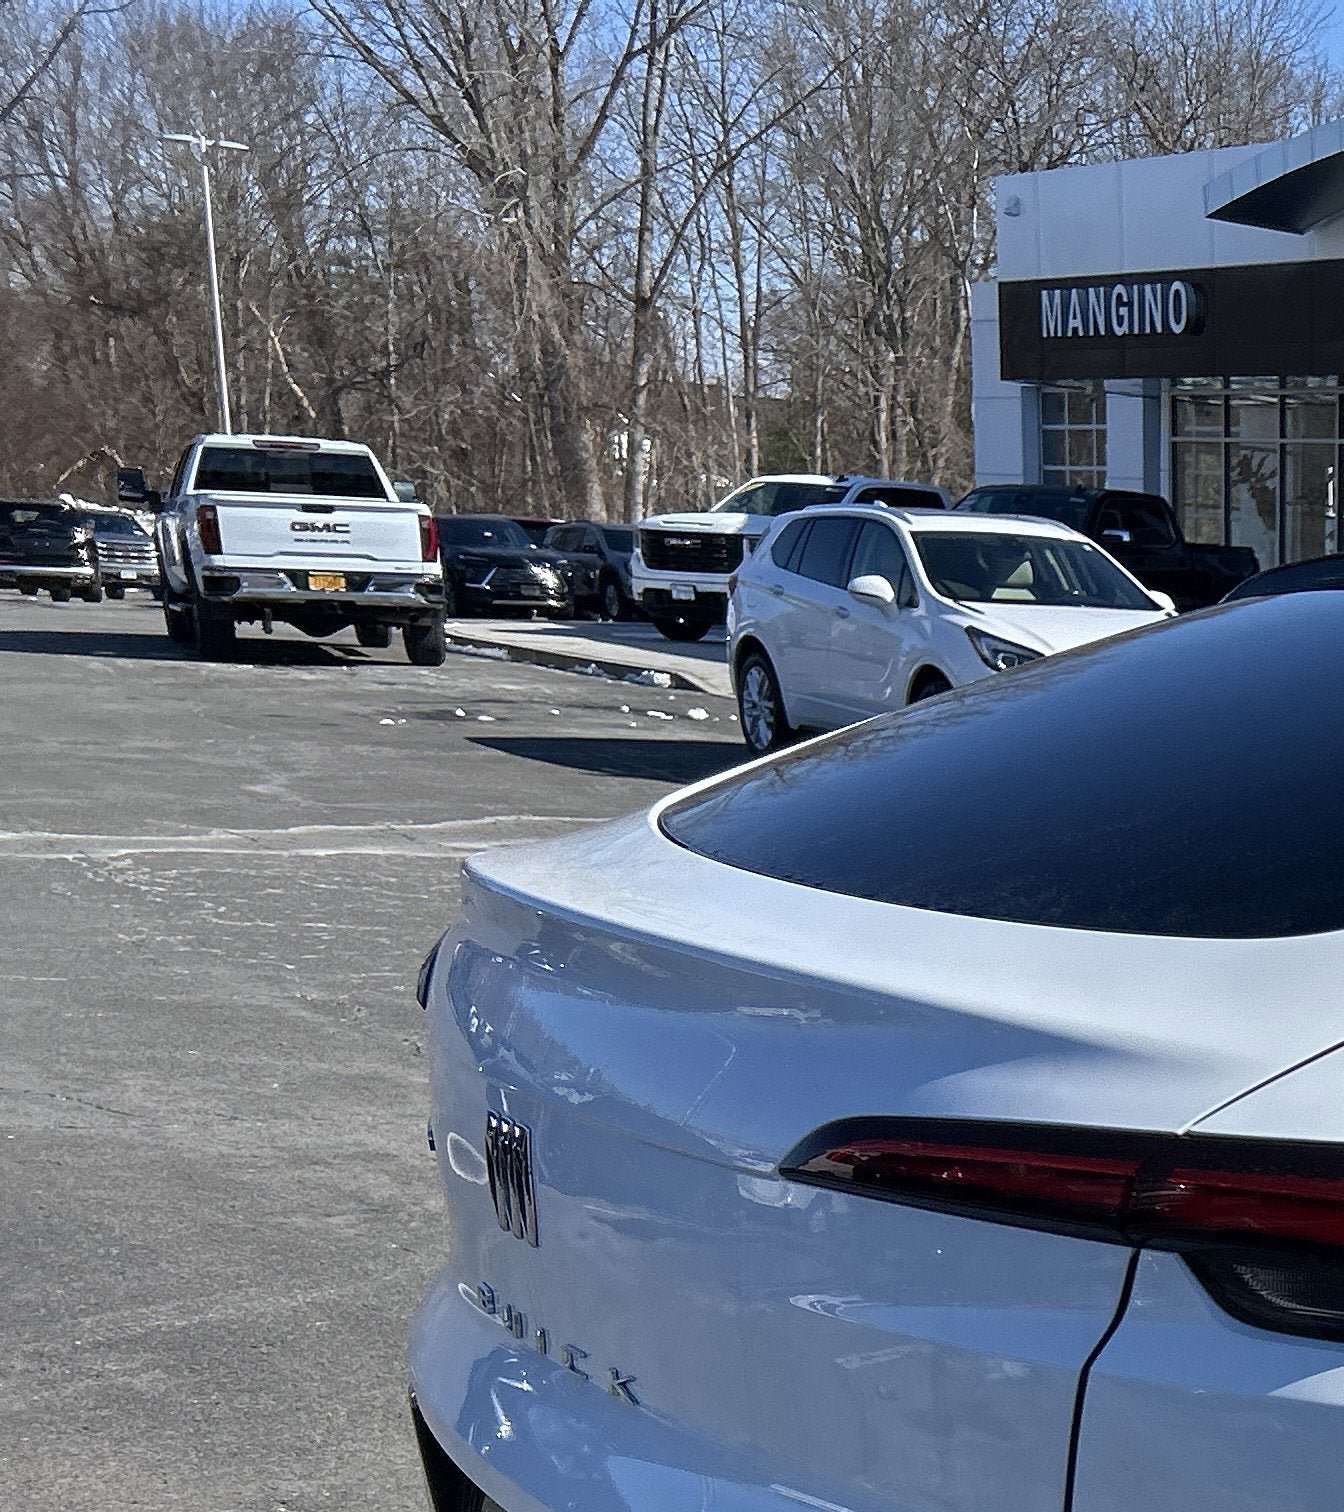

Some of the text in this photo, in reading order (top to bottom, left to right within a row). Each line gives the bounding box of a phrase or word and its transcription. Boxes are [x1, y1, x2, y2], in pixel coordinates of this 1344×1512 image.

[1041, 280, 1187, 338] MANGINO
[290, 520, 351, 533] GMC
[477, 1280, 640, 1405] BUICK
